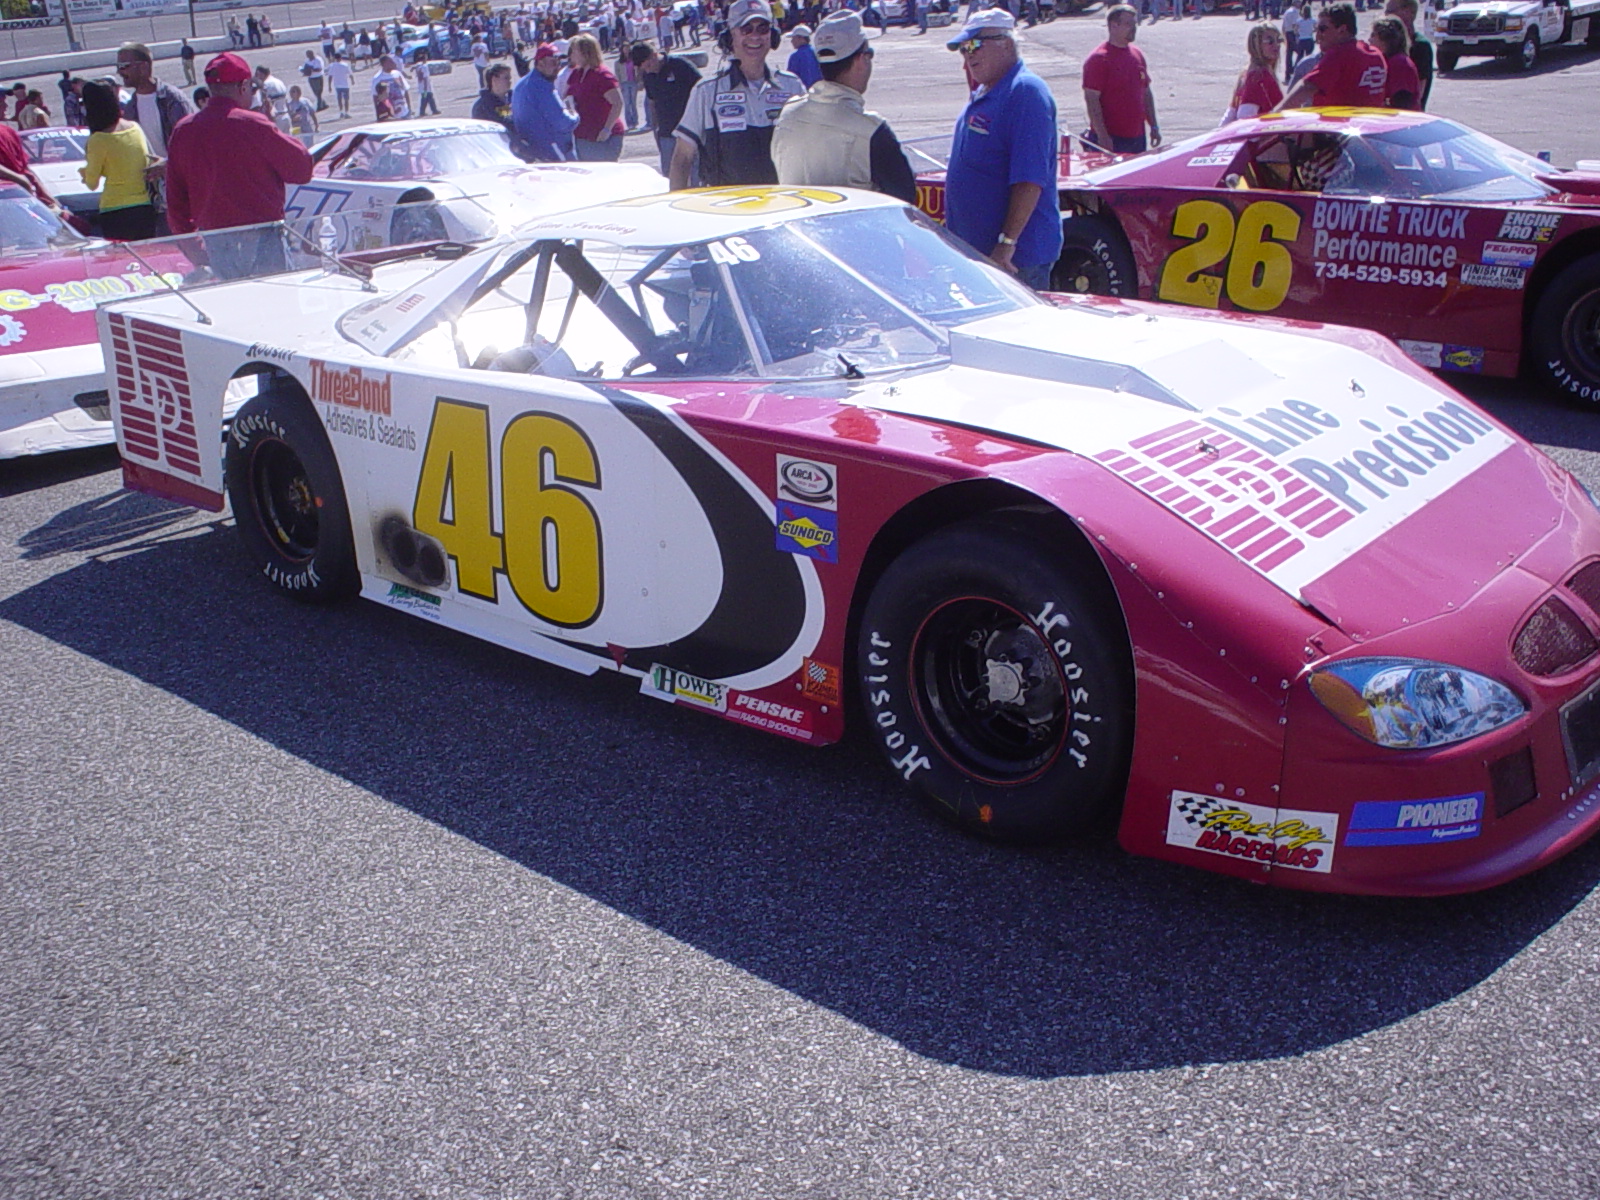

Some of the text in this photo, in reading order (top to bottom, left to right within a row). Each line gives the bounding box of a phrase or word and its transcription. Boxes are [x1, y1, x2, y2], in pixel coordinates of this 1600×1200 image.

[1312, 200, 1470, 240] BOWTIE TRUCK
[1497, 224, 1533, 240] PRO
[1503, 211, 1561, 229] ENGINE
[708, 236, 761, 265] 46
[1158, 199, 1302, 311] 26
[1312, 229, 1458, 269] Performance
[1313, 261, 1448, 289] 734-529-5934
[1500, 266, 1525, 279] LINE
[309, 358, 392, 417] ThreeBond
[231, 409, 286, 449] Hoosier
[325, 405, 416, 451] Adhesives & Sealants
[1201, 399, 1340, 458] Line
[791, 468, 813, 481] ARCA
[1288, 400, 1494, 514] Precision
[412, 395, 605, 630] 46
[781, 522, 832, 544] SUNOCO
[659, 665, 718, 697] HOWE
[1028, 601, 1102, 769] Hoosier
[735, 693, 805, 724] PENSKE
[864, 631, 932, 781] Hoosier
[1397, 797, 1478, 828] PIONEER
[1195, 830, 1324, 868] RACECARS
